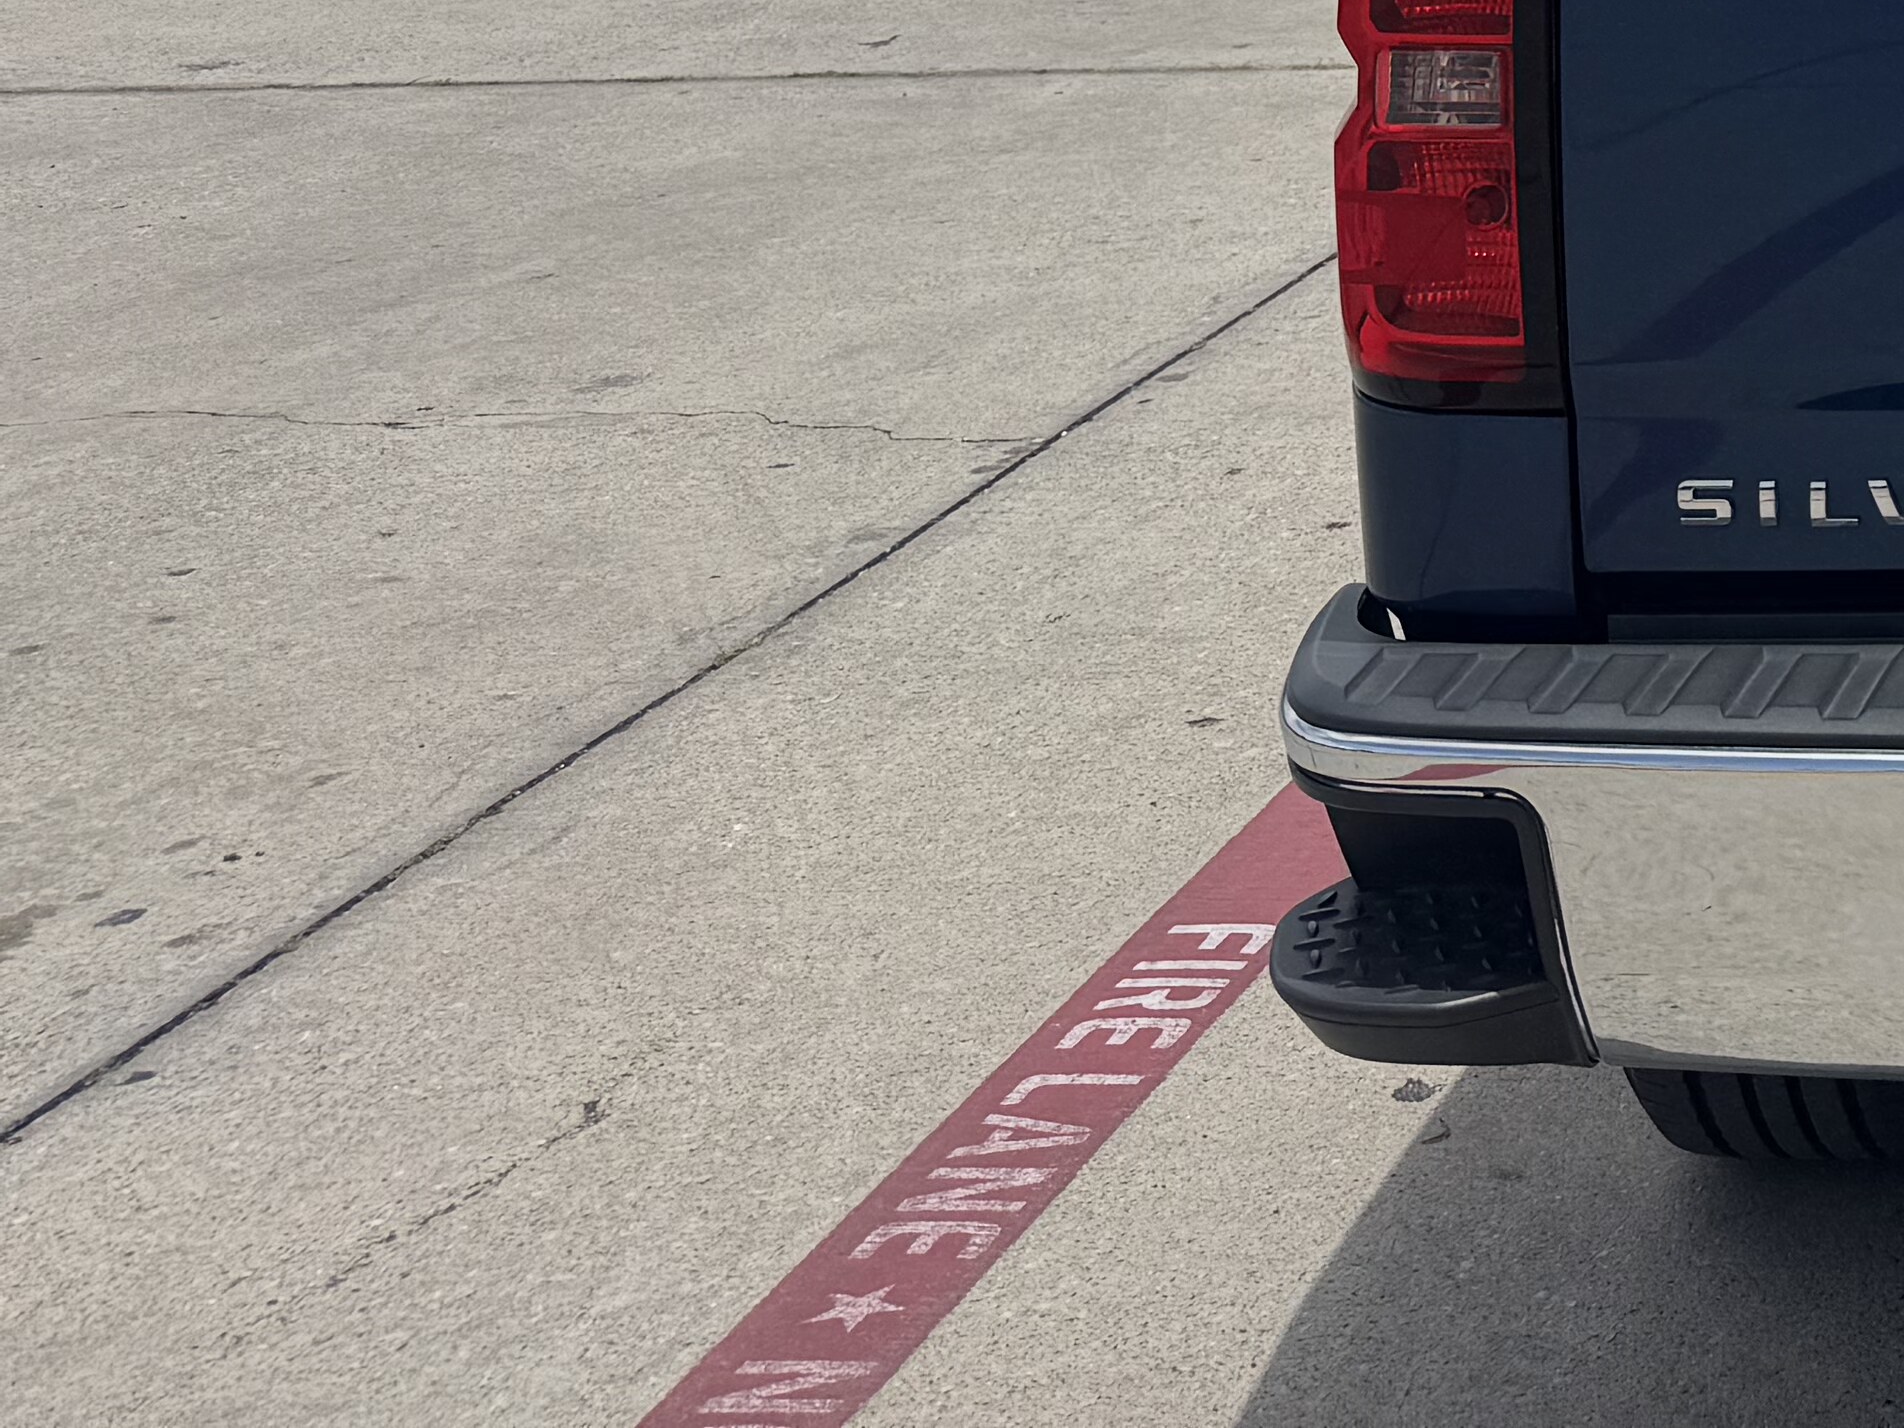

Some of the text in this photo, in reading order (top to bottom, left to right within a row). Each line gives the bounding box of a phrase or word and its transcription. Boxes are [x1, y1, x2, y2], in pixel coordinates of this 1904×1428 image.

[698, 923, 1276, 1428] FIRE LANE N
